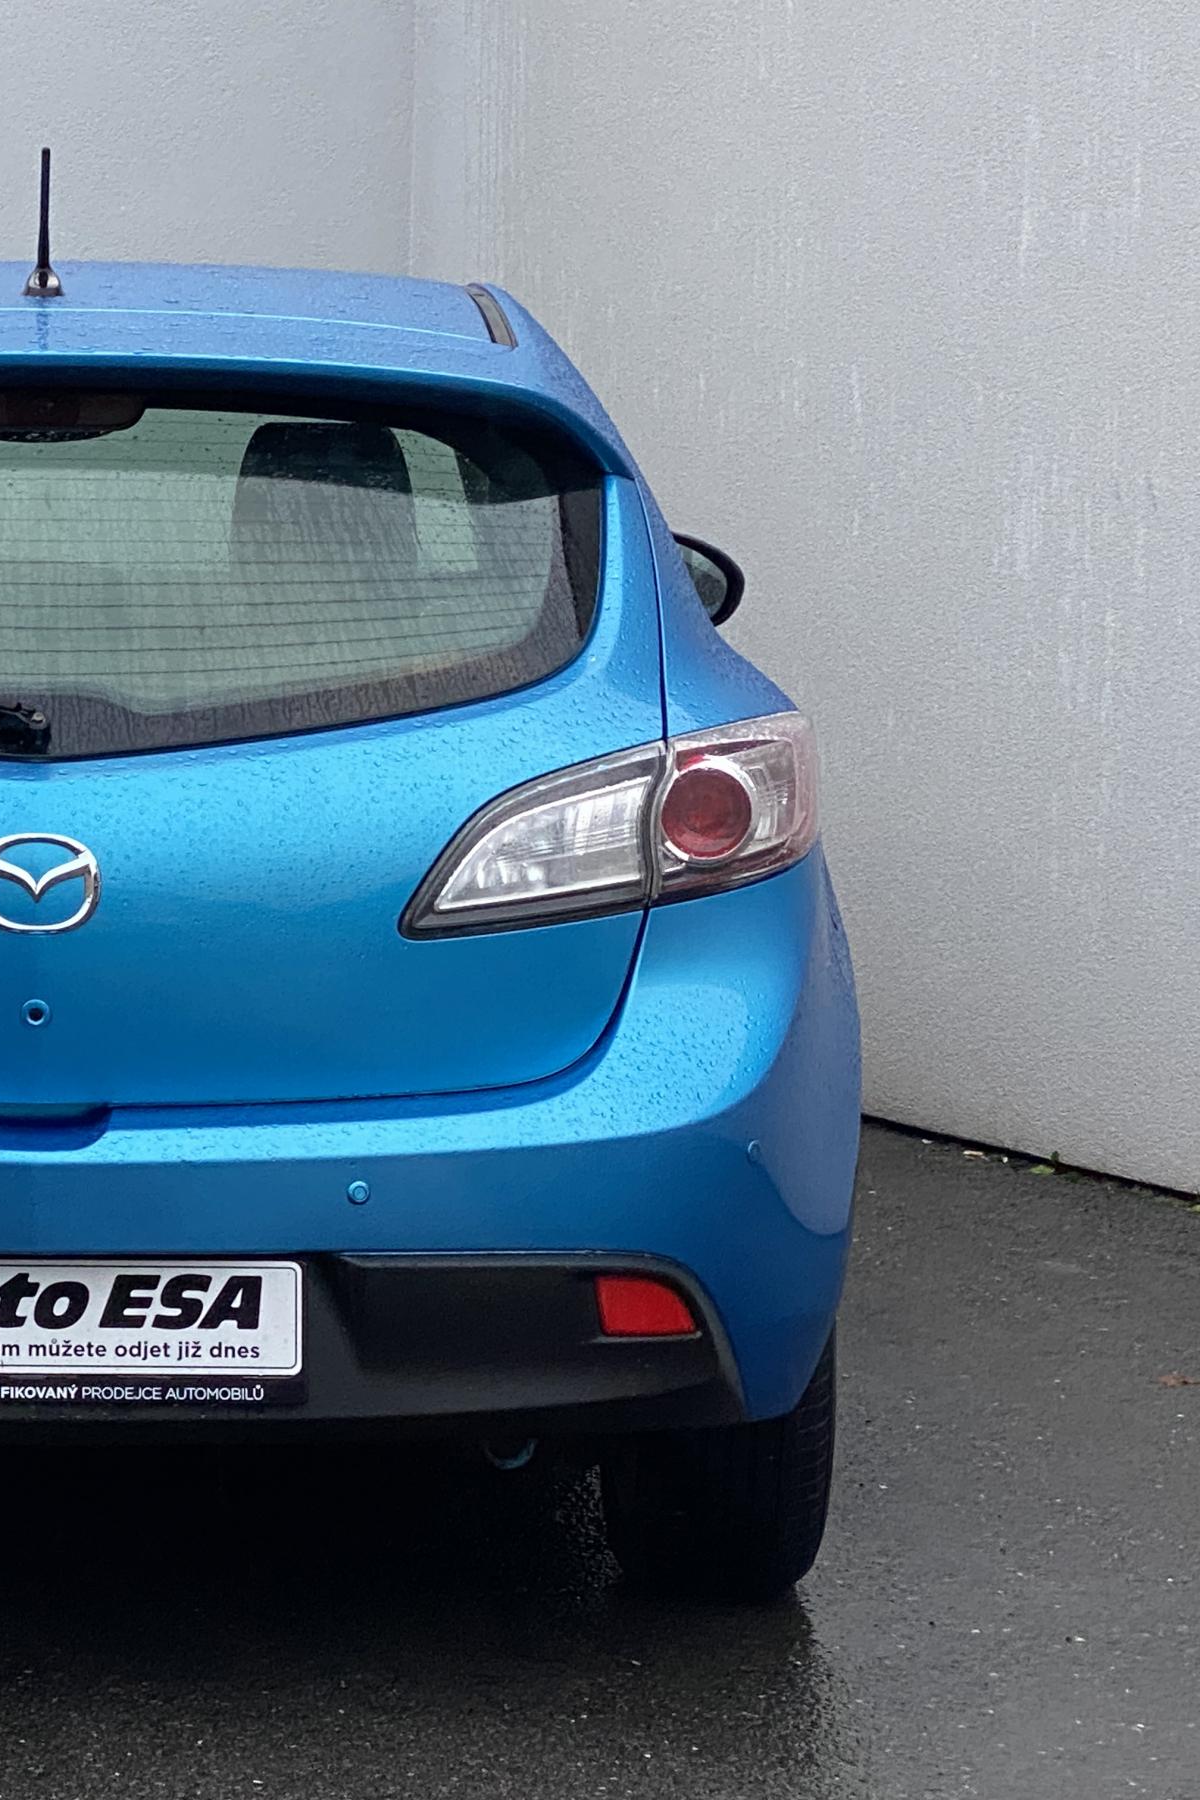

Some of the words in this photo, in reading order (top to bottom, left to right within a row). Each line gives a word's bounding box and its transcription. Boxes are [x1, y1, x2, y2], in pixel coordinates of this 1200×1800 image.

[99, 1274, 262, 1331] ESA
[28, 1338, 107, 1359] můžete
[114, 1340, 171, 1363] odjet
[177, 1340, 202, 1363] již
[209, 1341, 260, 1359] dnes
[82, 1386, 162, 1401] PRODEJCE
[165, 1383, 264, 1401] AUTOMOBILŮ
